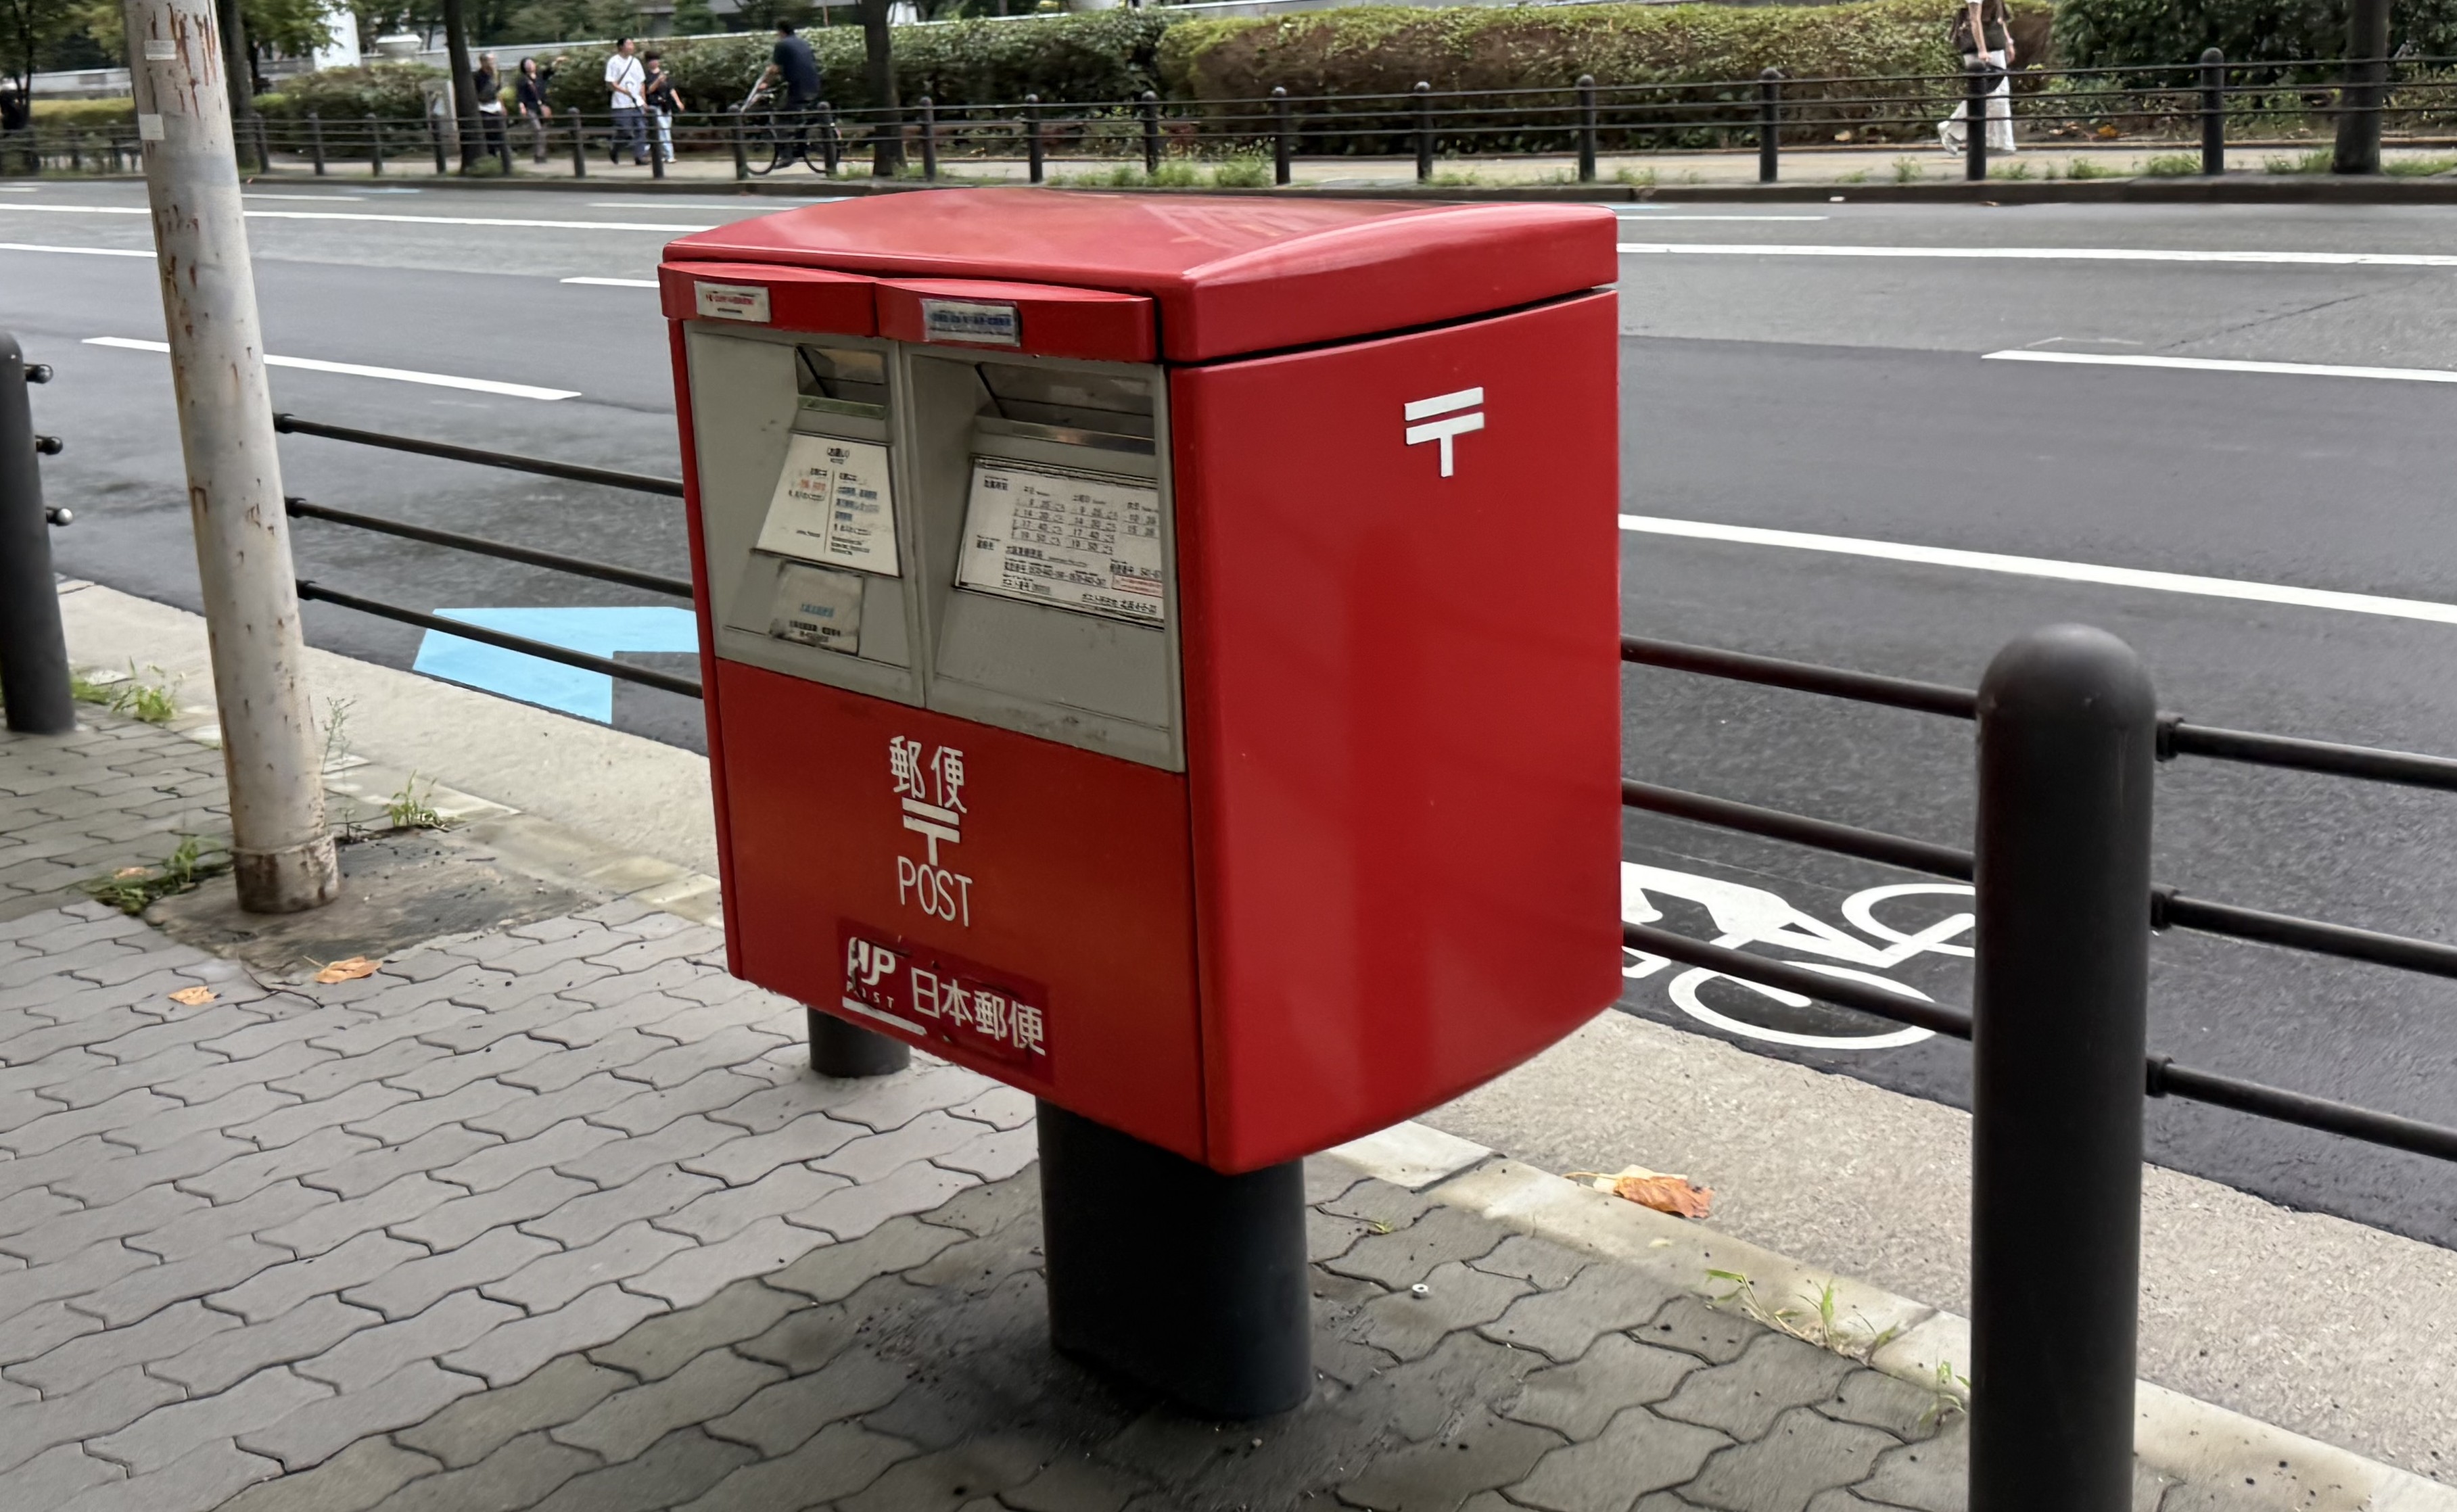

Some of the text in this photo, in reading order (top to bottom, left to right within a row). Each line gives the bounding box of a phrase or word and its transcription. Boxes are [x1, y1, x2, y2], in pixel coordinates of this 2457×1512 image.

[889, 736, 967, 813] 郵便
[897, 855, 973, 927] POST
[911, 966, 1046, 1056] 日本郵便
